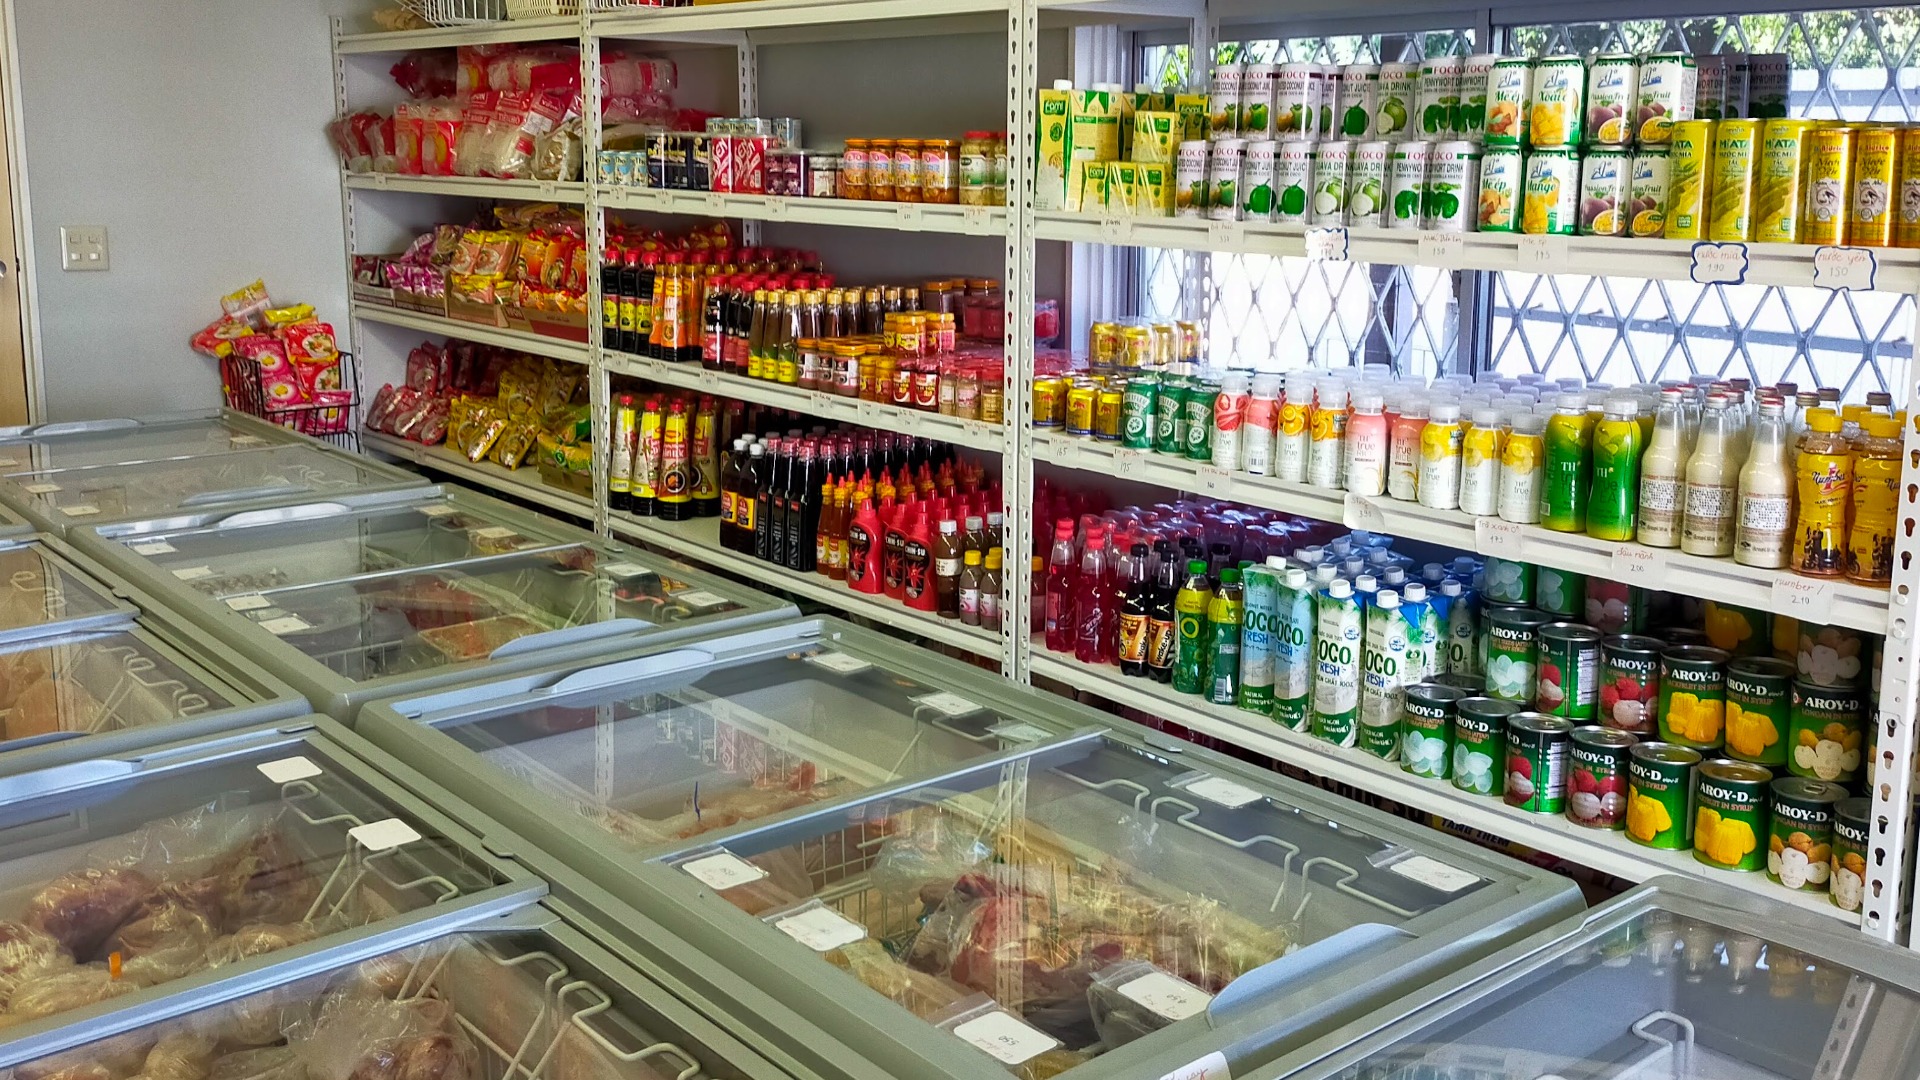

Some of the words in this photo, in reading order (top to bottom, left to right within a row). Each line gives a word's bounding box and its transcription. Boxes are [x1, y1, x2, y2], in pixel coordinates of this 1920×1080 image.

[1490, 626, 1533, 640] AROY-D
[1610, 657, 1657, 671] AROY-D
[1671, 668, 1721, 682] AROY-D
[1405, 701, 1445, 719] AROY-D
[1804, 696, 1860, 711] AROY-D
[1571, 747, 1616, 766] AROY-D
[1699, 782, 1750, 803] AROY-D
[1730, 804, 1754, 812] SYRUP
[1774, 802, 1828, 822] AROY-D
